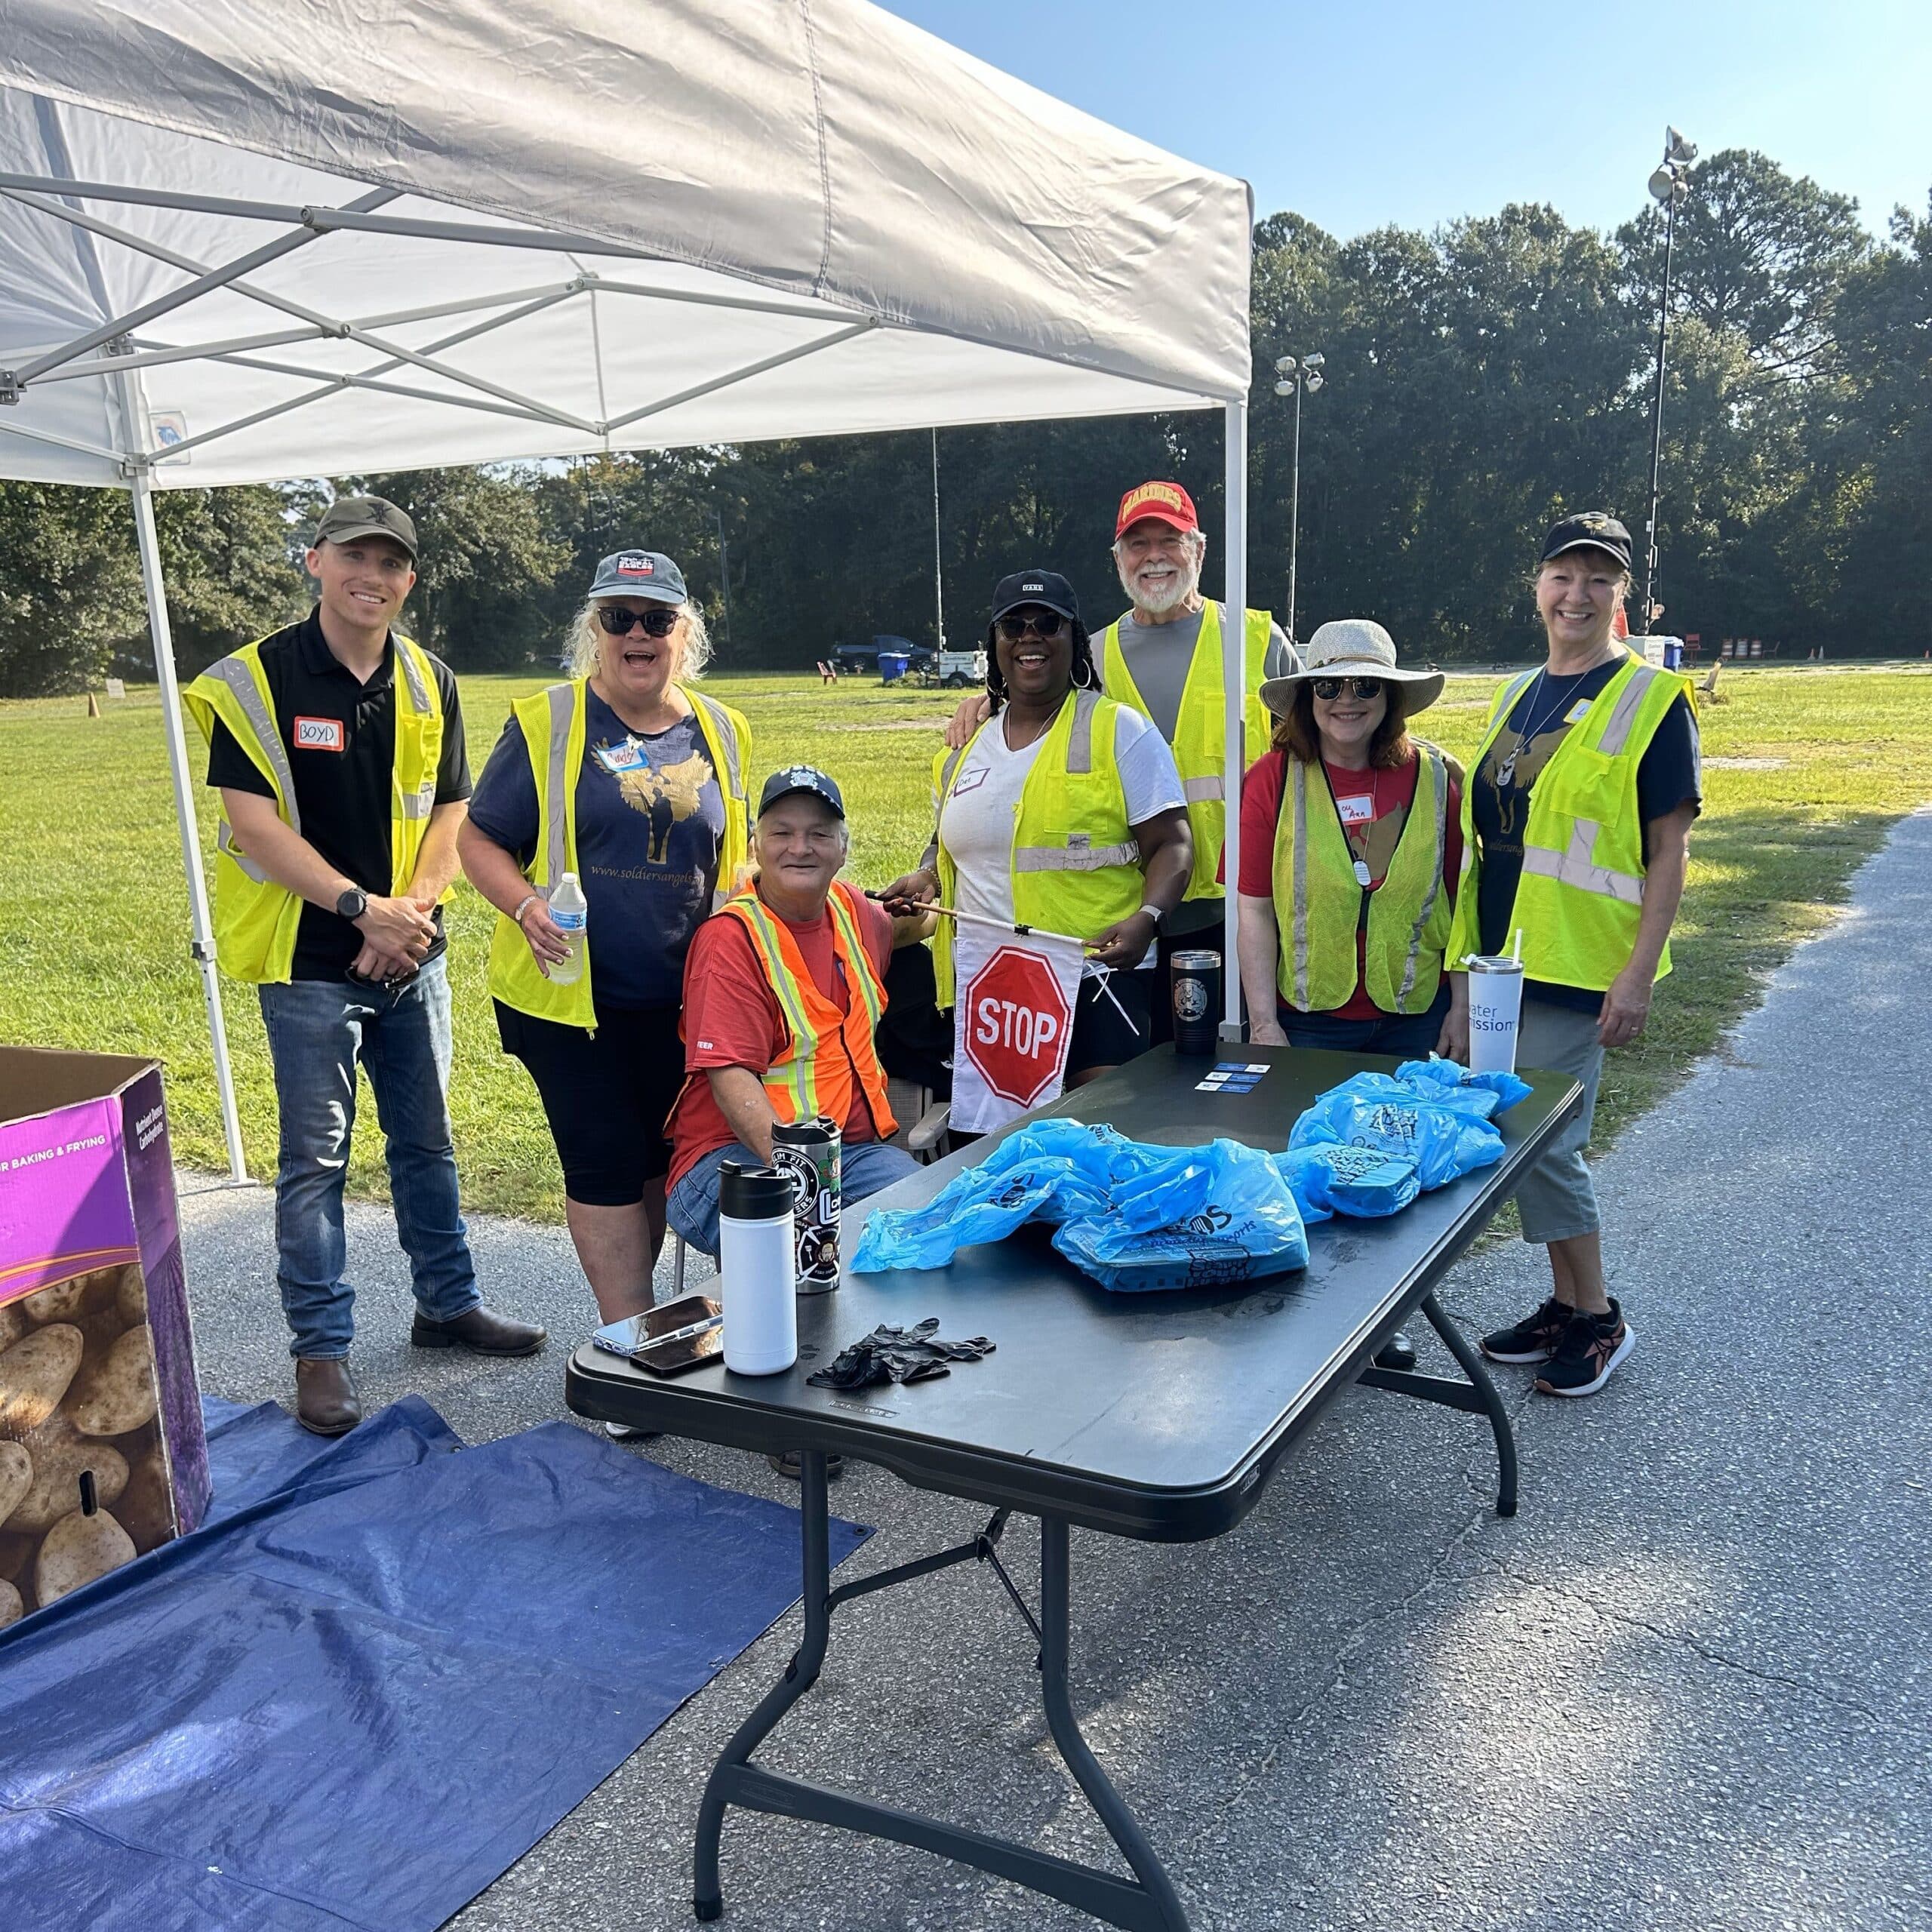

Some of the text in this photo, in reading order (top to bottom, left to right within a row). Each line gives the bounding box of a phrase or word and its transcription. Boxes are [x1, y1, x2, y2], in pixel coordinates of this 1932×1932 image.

[1122, 483, 1182, 524] MARINES
[300, 724, 334, 743] BOYD
[1470, 1004, 1498, 1018] ater
[976, 996, 1057, 1060] STOP
[1471, 1016, 1512, 1032] ission
[11, 1149, 54, 1170] BAKING
[56, 1146, 64, 1157] &
[66, 1134, 106, 1153] FRYING
[789, 1155, 807, 1168] FIT
[794, 1195, 814, 1214] ERS
